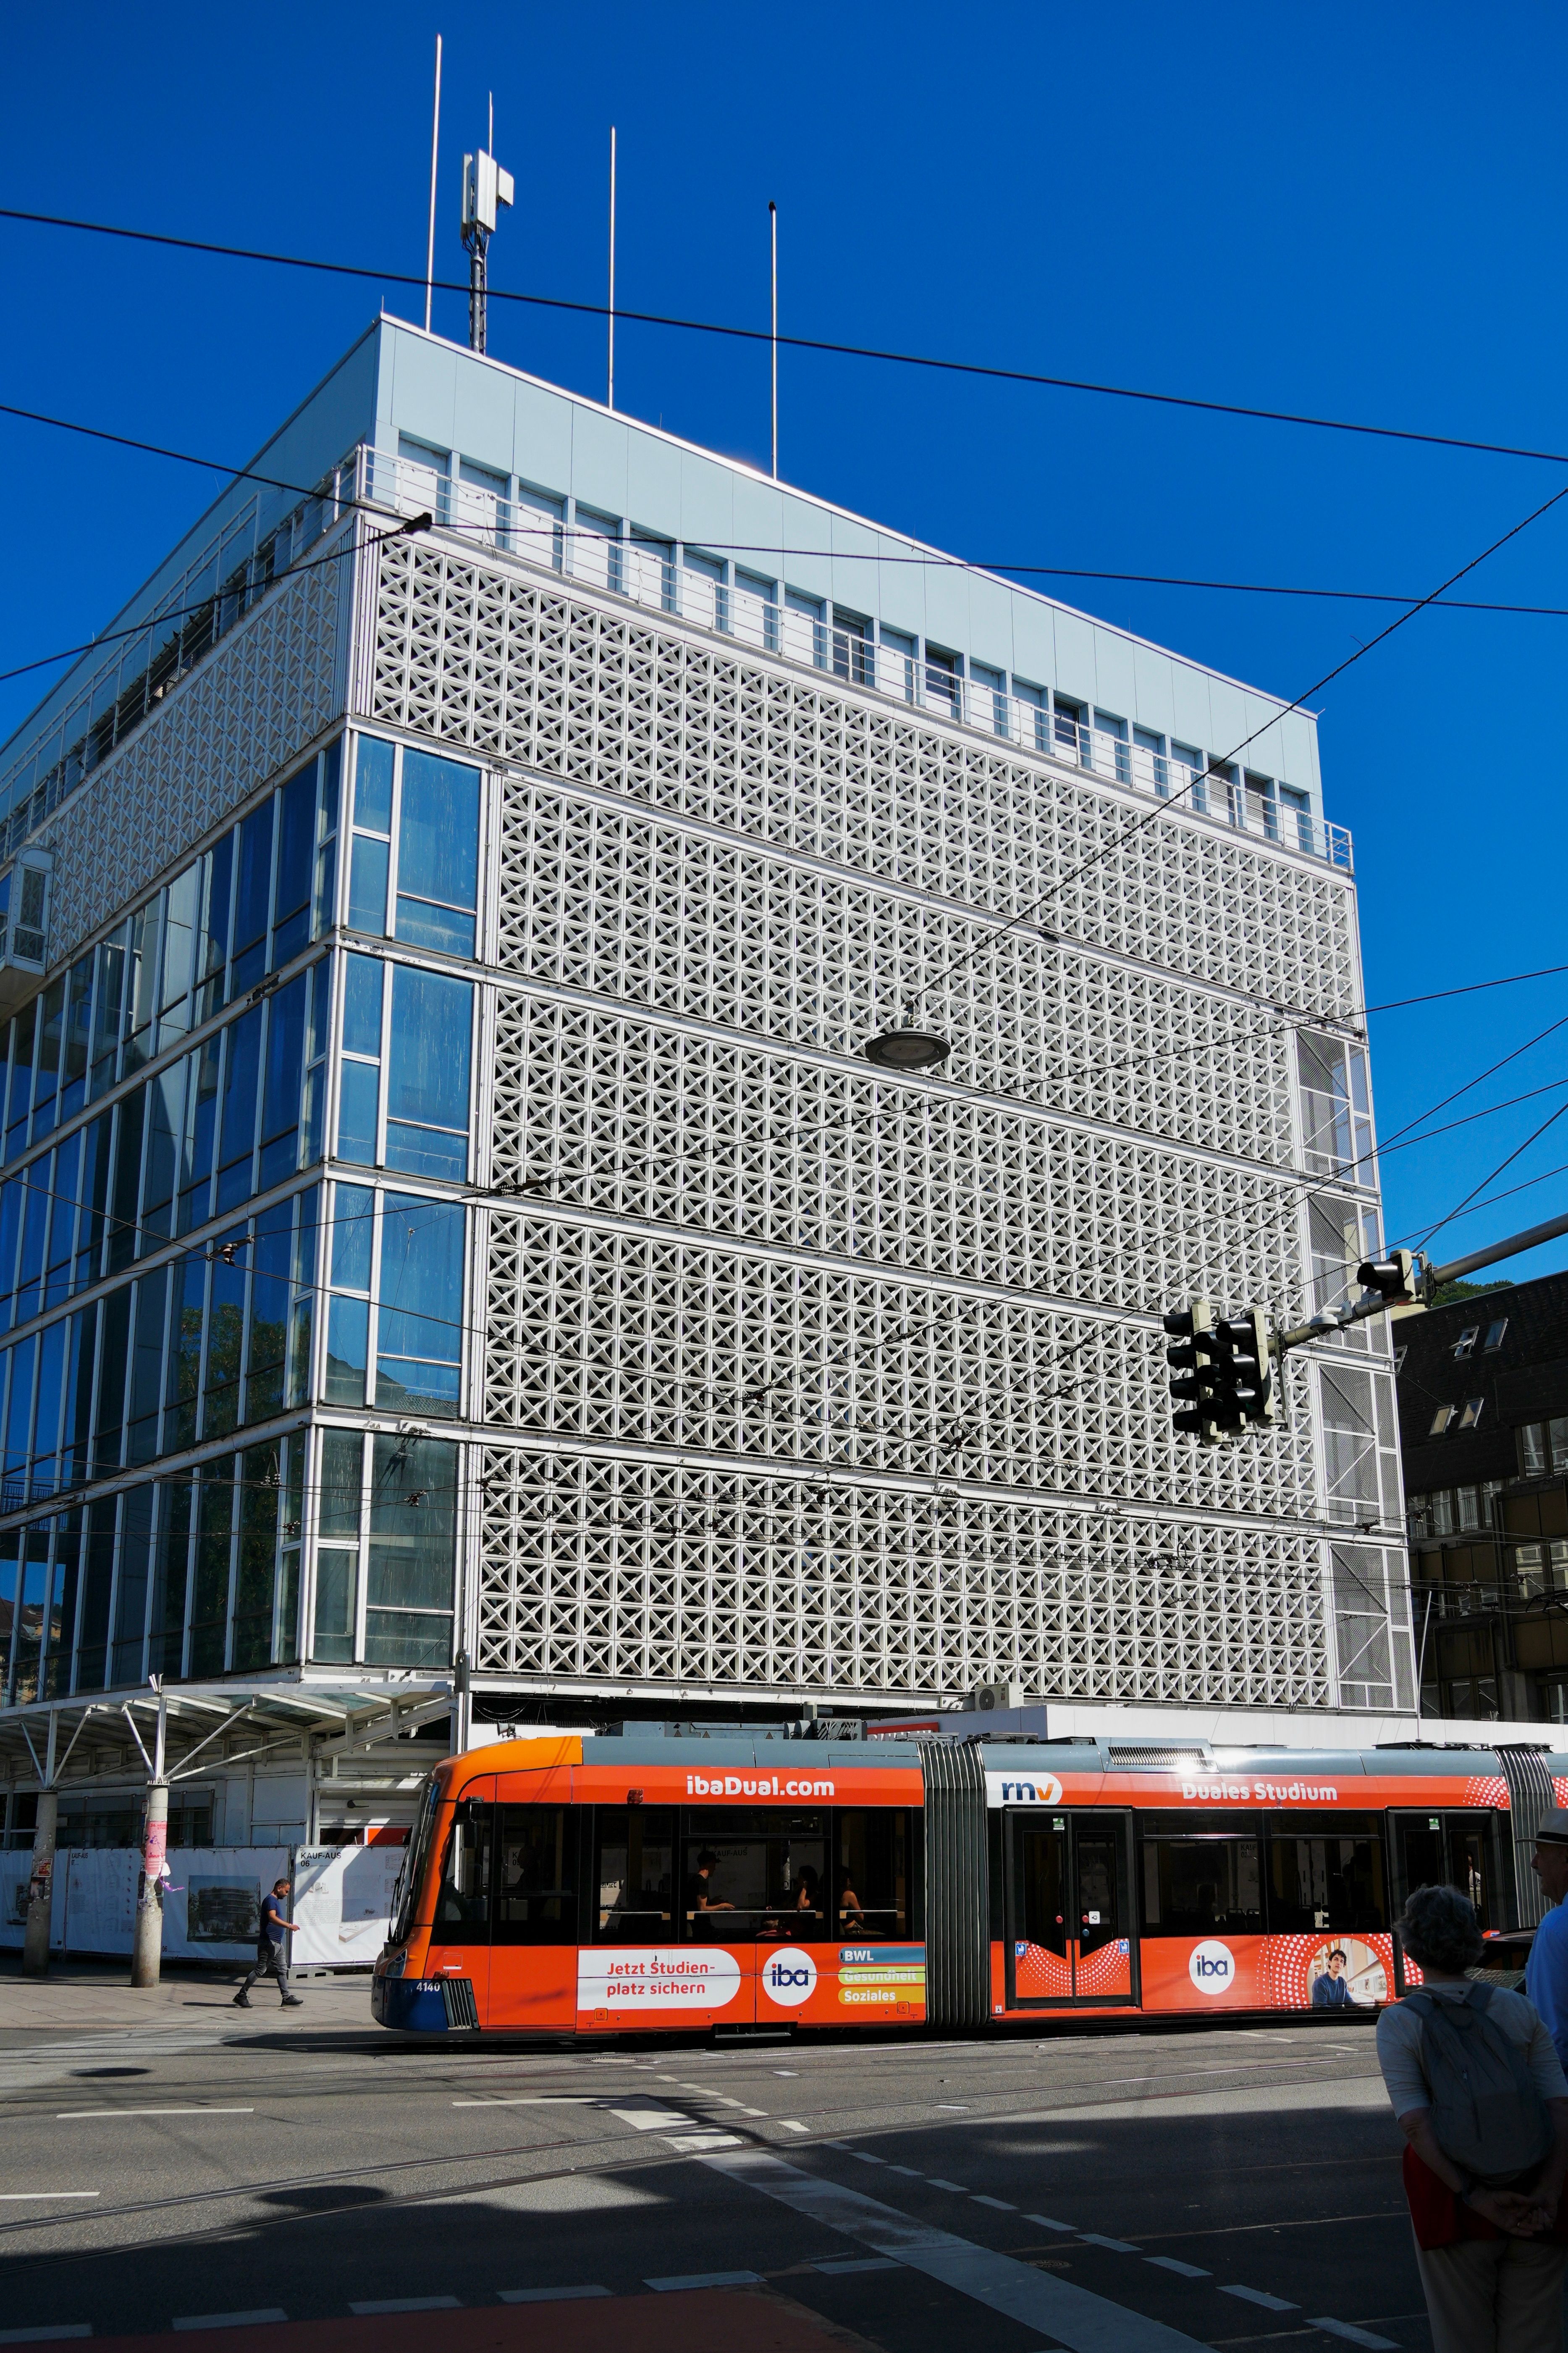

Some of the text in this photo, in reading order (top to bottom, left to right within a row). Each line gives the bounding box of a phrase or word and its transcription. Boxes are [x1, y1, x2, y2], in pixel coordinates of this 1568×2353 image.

[687, 1775, 834, 1796] ibaDual.com
[1002, 1783, 1054, 1800] rnv
[1181, 1783, 1337, 1800] Duales Studium
[844, 1950, 874, 1961] BWL
[607, 1961, 715, 1975] Jetzt Studien-
[1196, 1954, 1228, 1977] iba
[771, 1963, 809, 1986] iba
[844, 1969, 917, 1982] Gesundheit
[416, 1982, 440, 1992] 4140
[607, 1982, 705, 1998] platz sichern
[844, 1989, 896, 2001] Soziales
